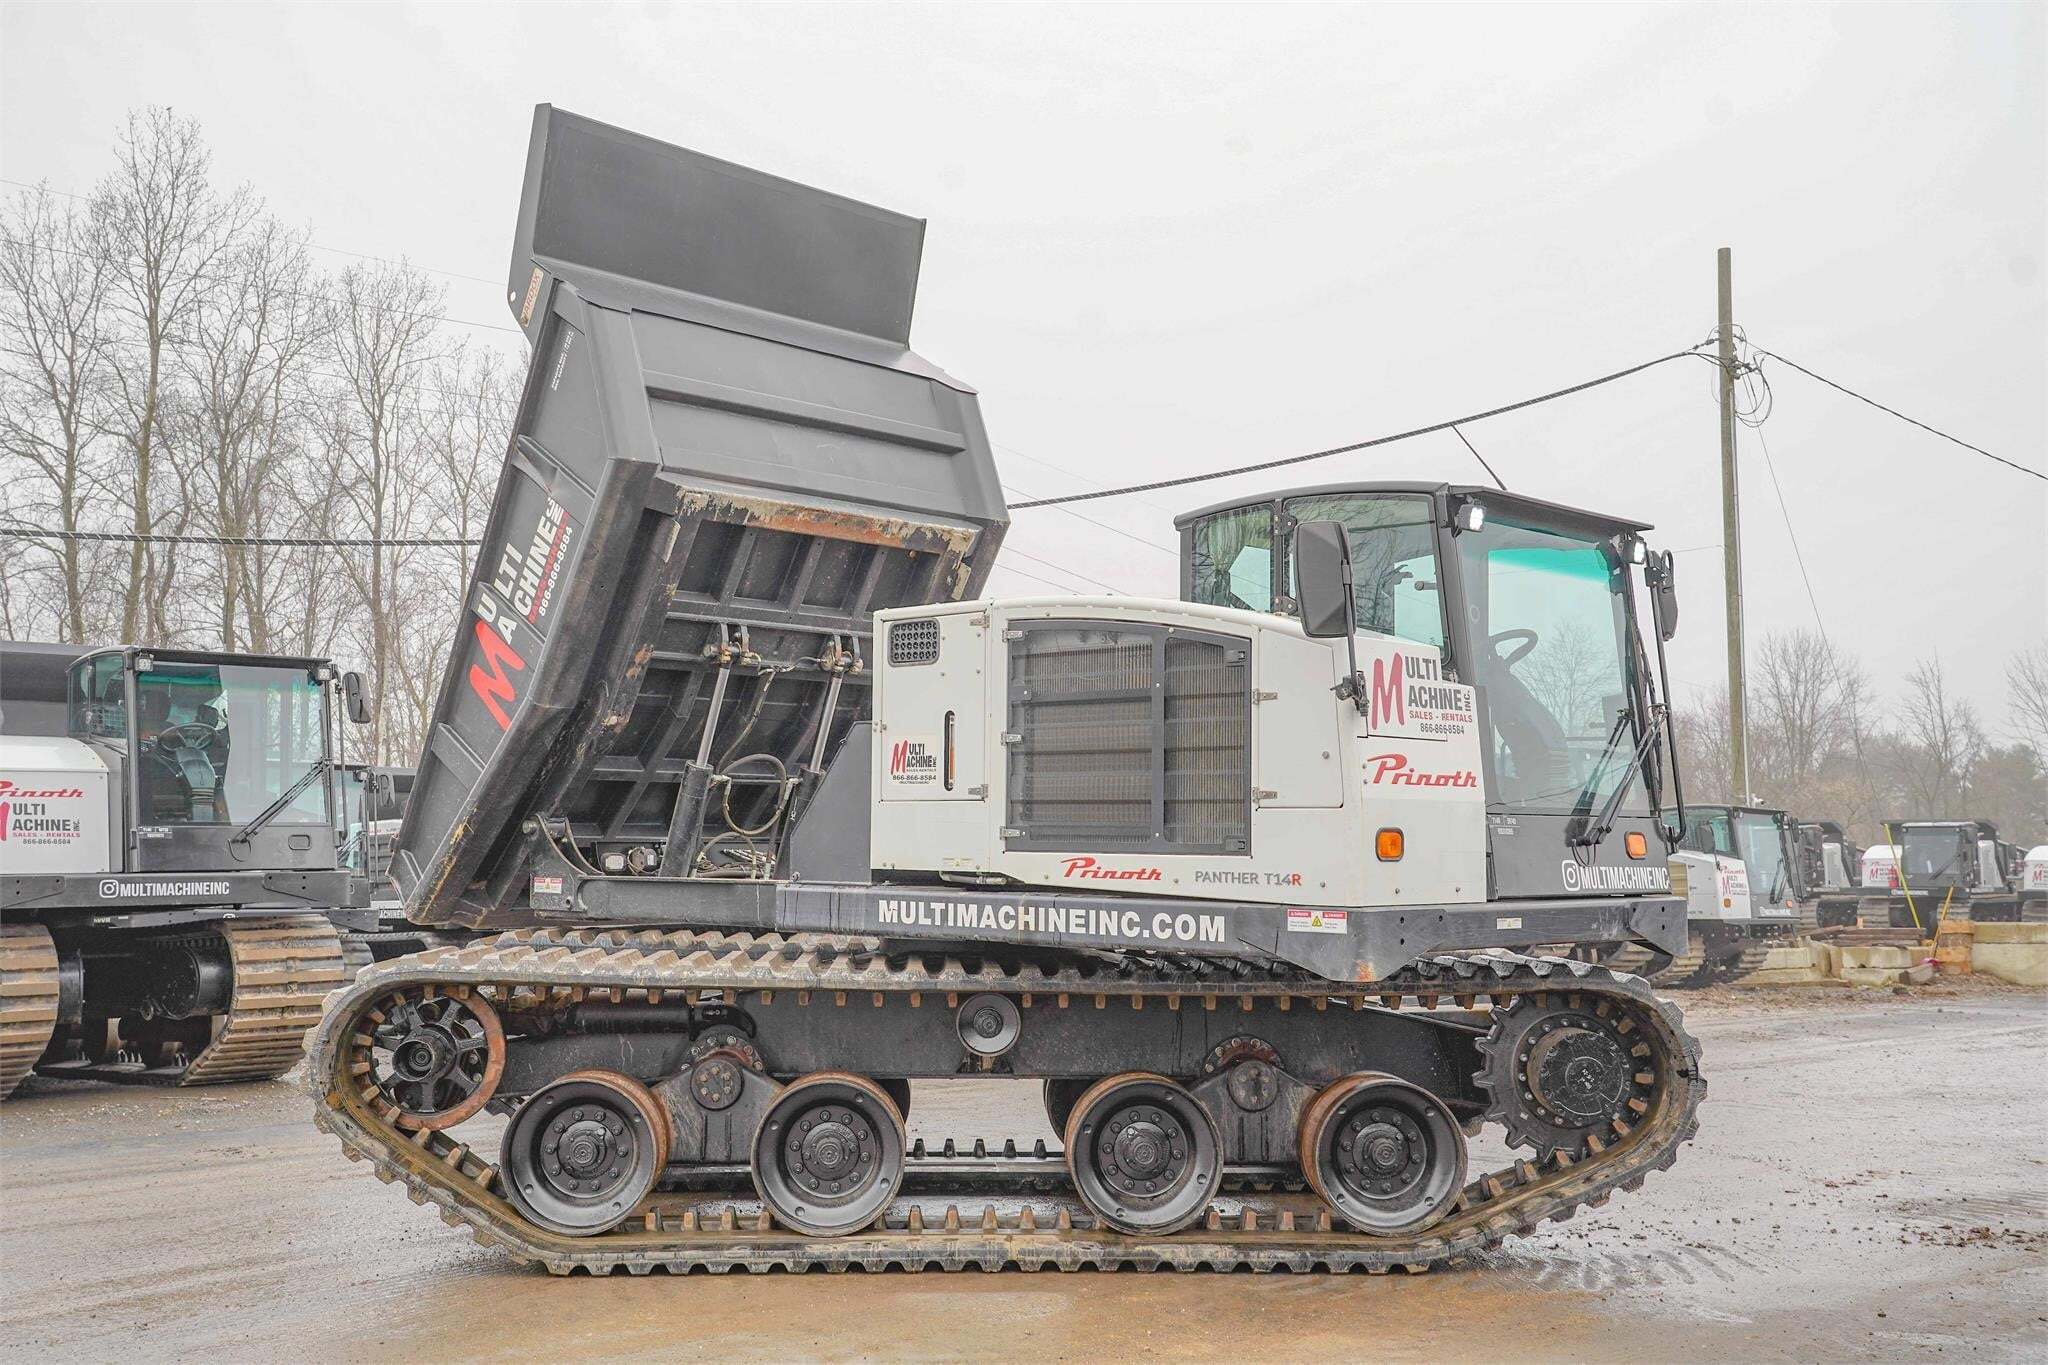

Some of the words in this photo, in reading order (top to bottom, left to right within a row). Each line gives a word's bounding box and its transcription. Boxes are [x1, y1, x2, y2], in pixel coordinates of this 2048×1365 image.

[1409, 710, 1433, 720] SALES
[1441, 713, 1473, 723] RENTALS
[1367, 753, 1477, 787] Prinoth
[1061, 856, 1161, 880] Prinoth
[1195, 870, 1260, 885] PANTHER
[1264, 872, 1302, 886] T14R
[1580, 865, 1670, 890] MULTIMACHINEINC
[120, 881, 230, 897] MULTIMACHINEINC
[878, 900, 1226, 942] MULTIMACHINEINC.COM
